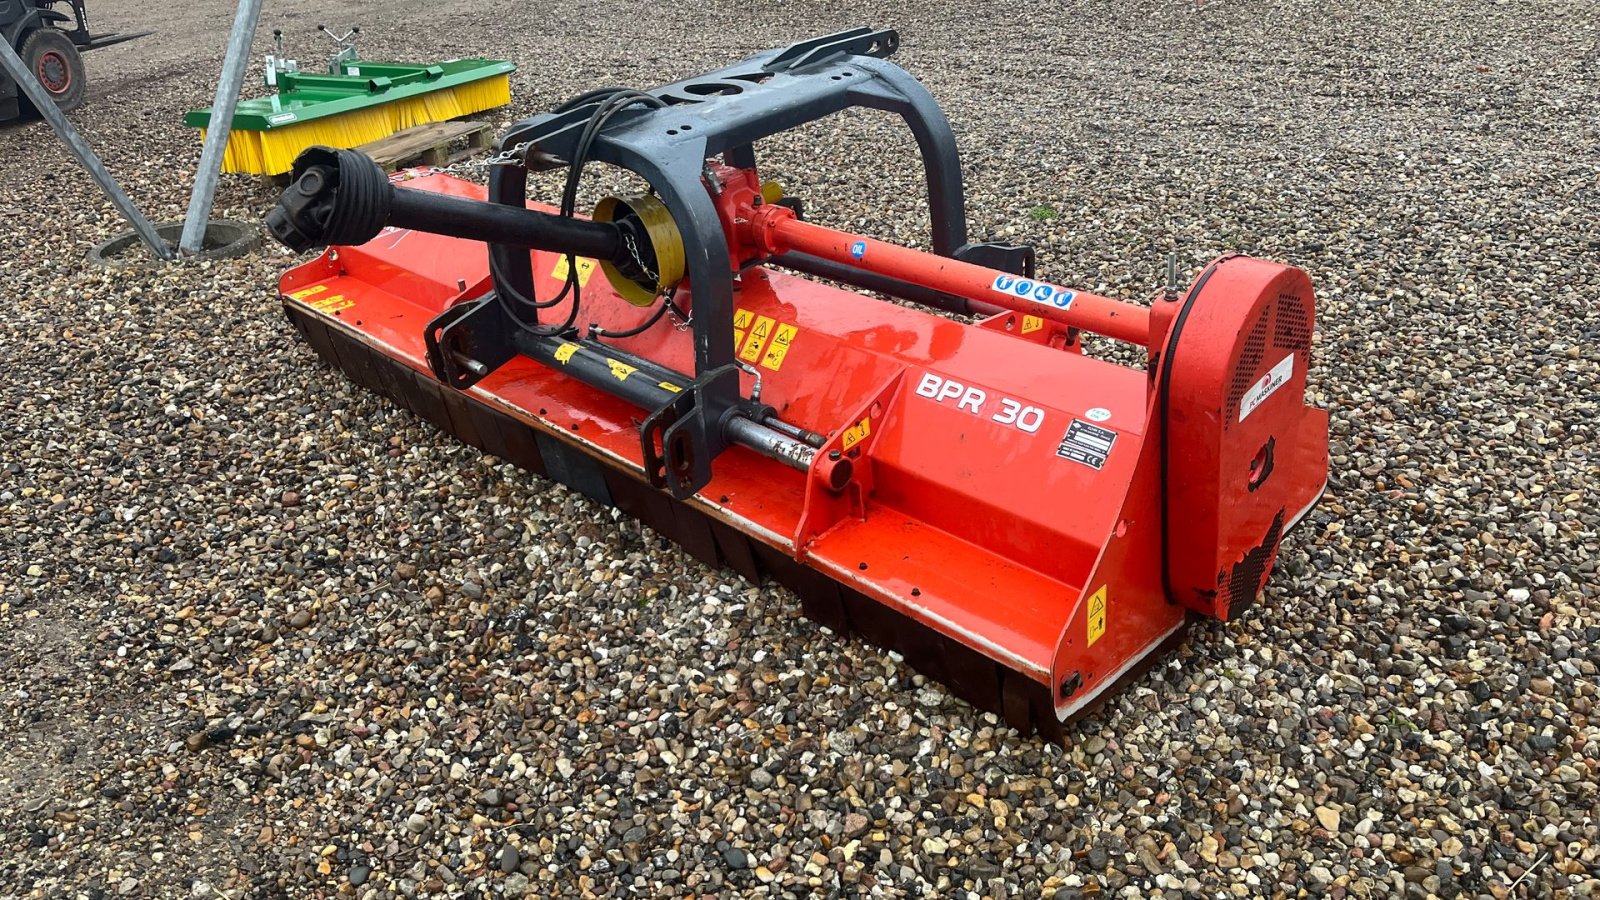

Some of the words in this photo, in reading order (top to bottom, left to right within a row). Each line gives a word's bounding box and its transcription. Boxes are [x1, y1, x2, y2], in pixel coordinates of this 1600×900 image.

[852, 244, 863, 254] OIL
[1256, 375, 1282, 401] MASKINER
[915, 372, 986, 414] BPR
[992, 397, 1045, 433] 30
